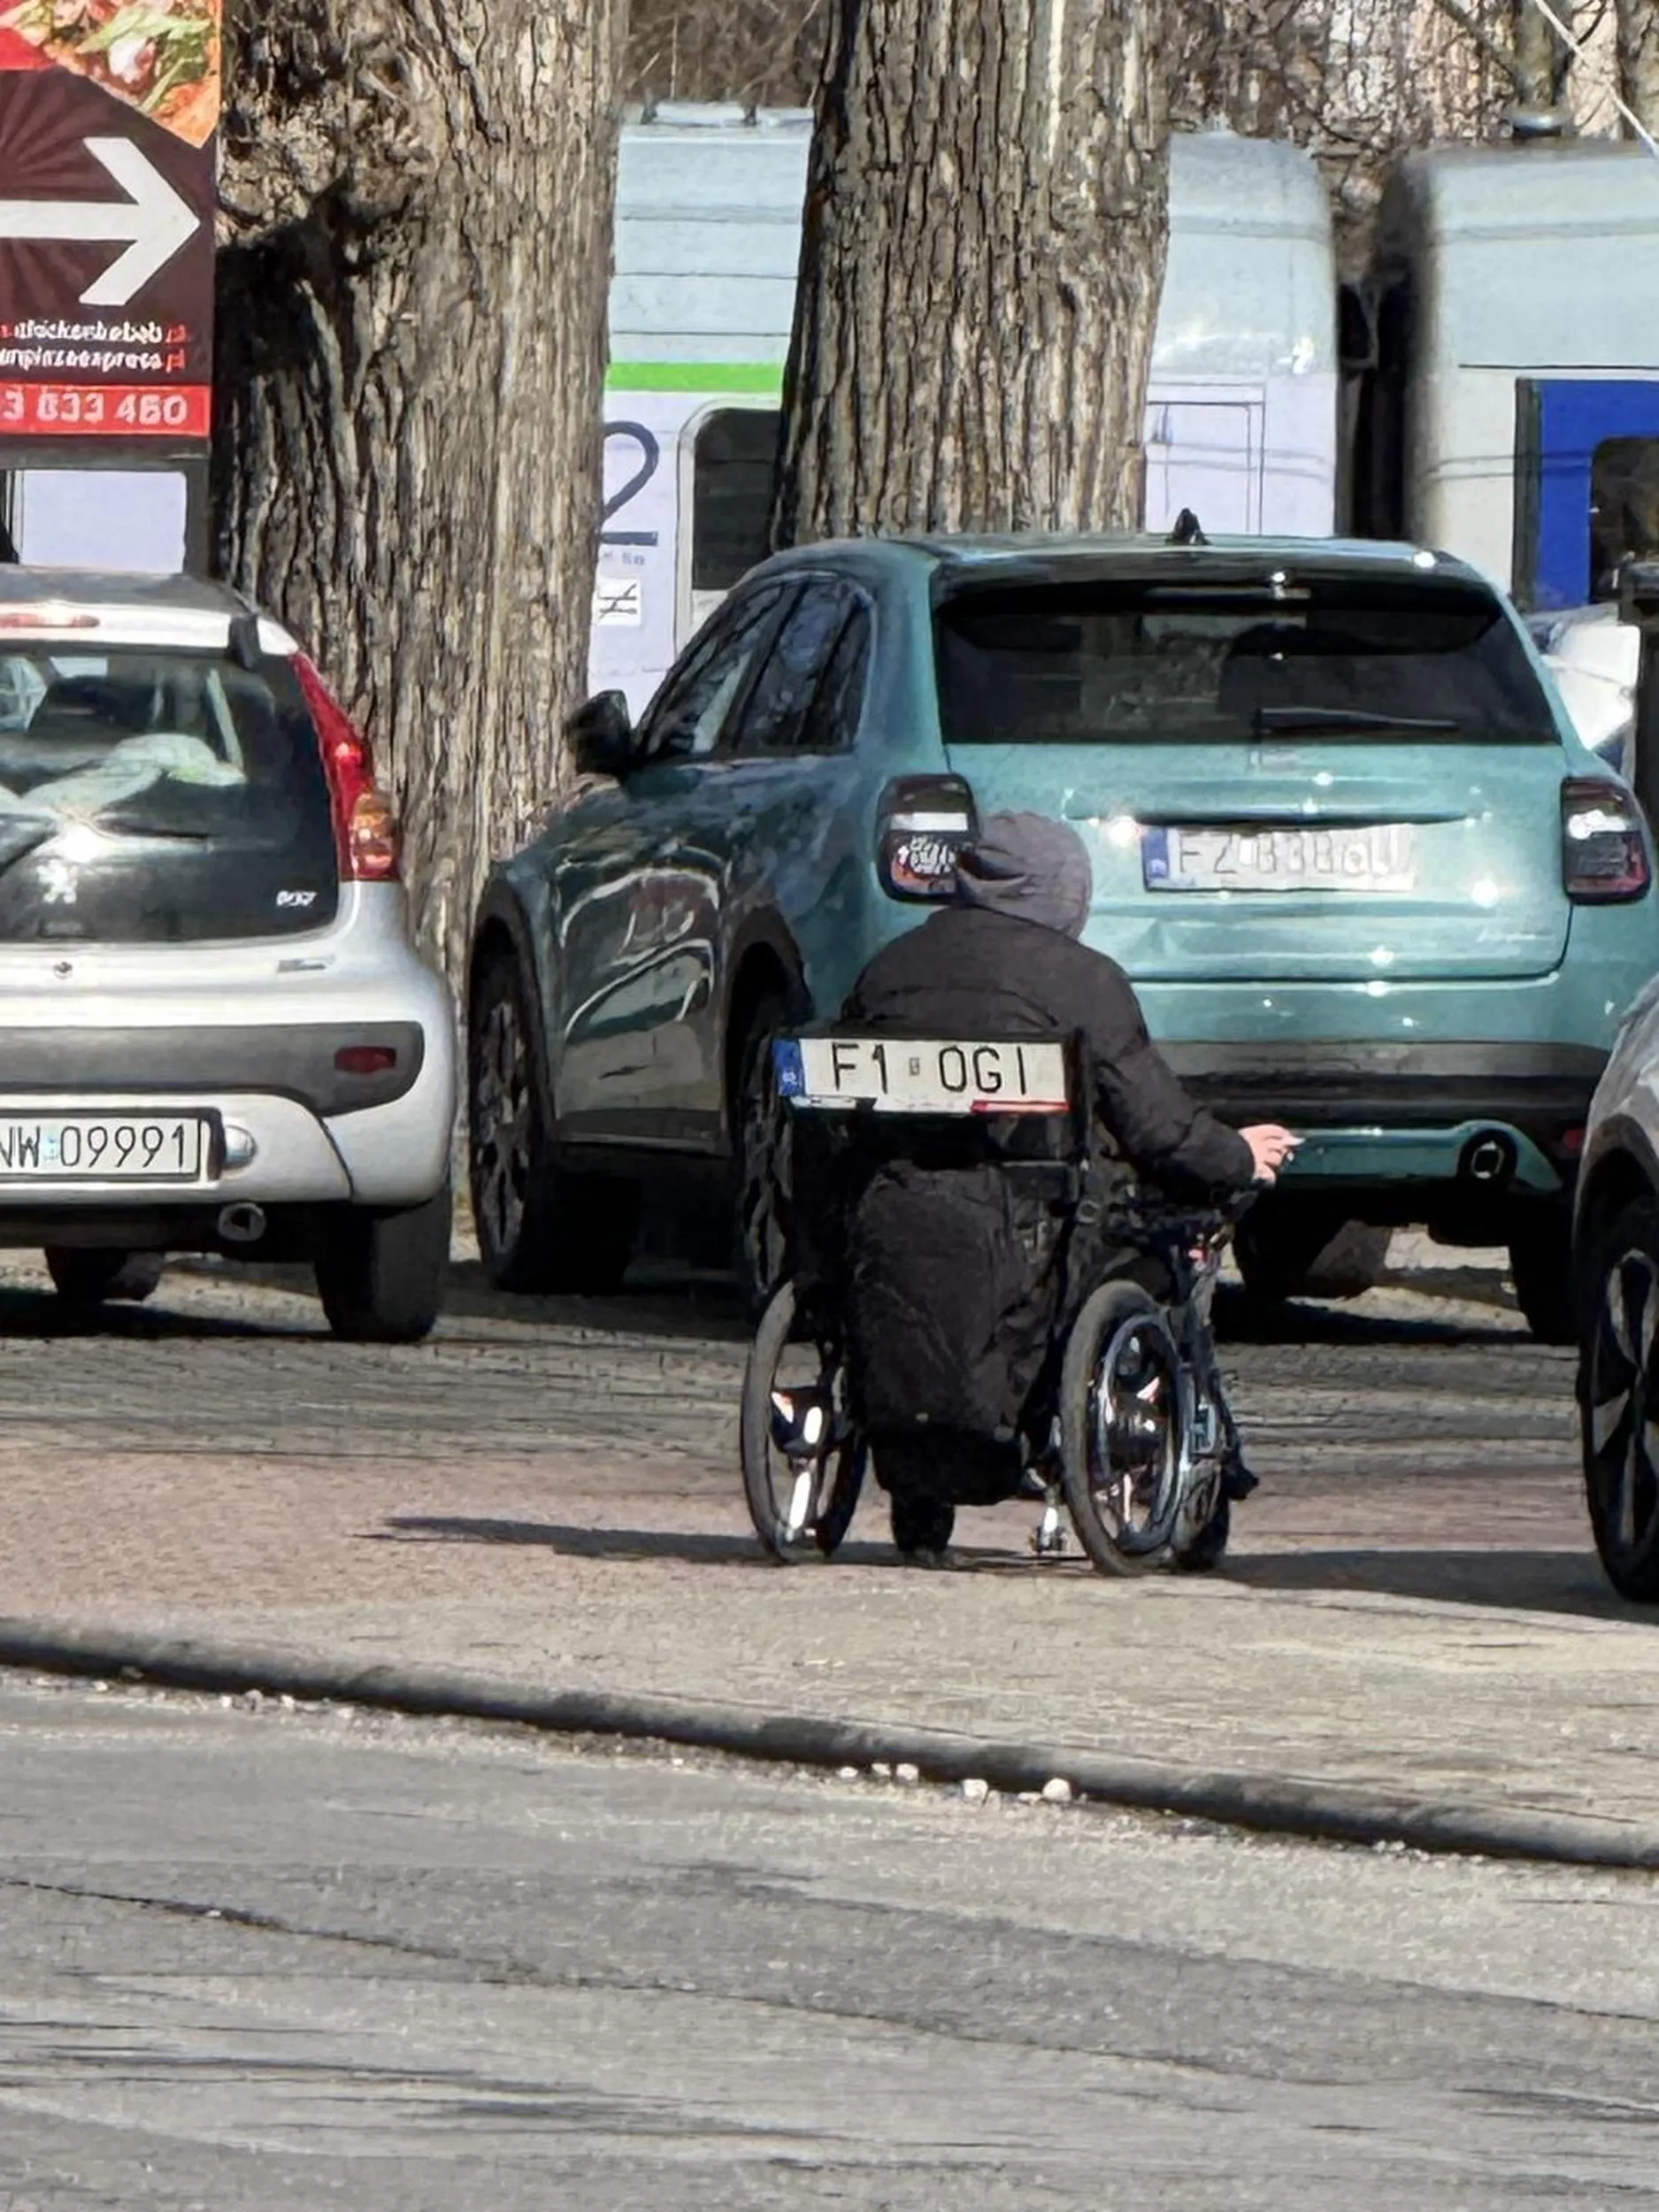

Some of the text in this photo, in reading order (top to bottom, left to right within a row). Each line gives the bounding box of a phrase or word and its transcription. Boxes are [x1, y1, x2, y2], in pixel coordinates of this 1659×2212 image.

[600, 420, 659, 546] 2
[832, 1041, 888, 1094] F1
[59, 1124, 184, 1168] 09991
